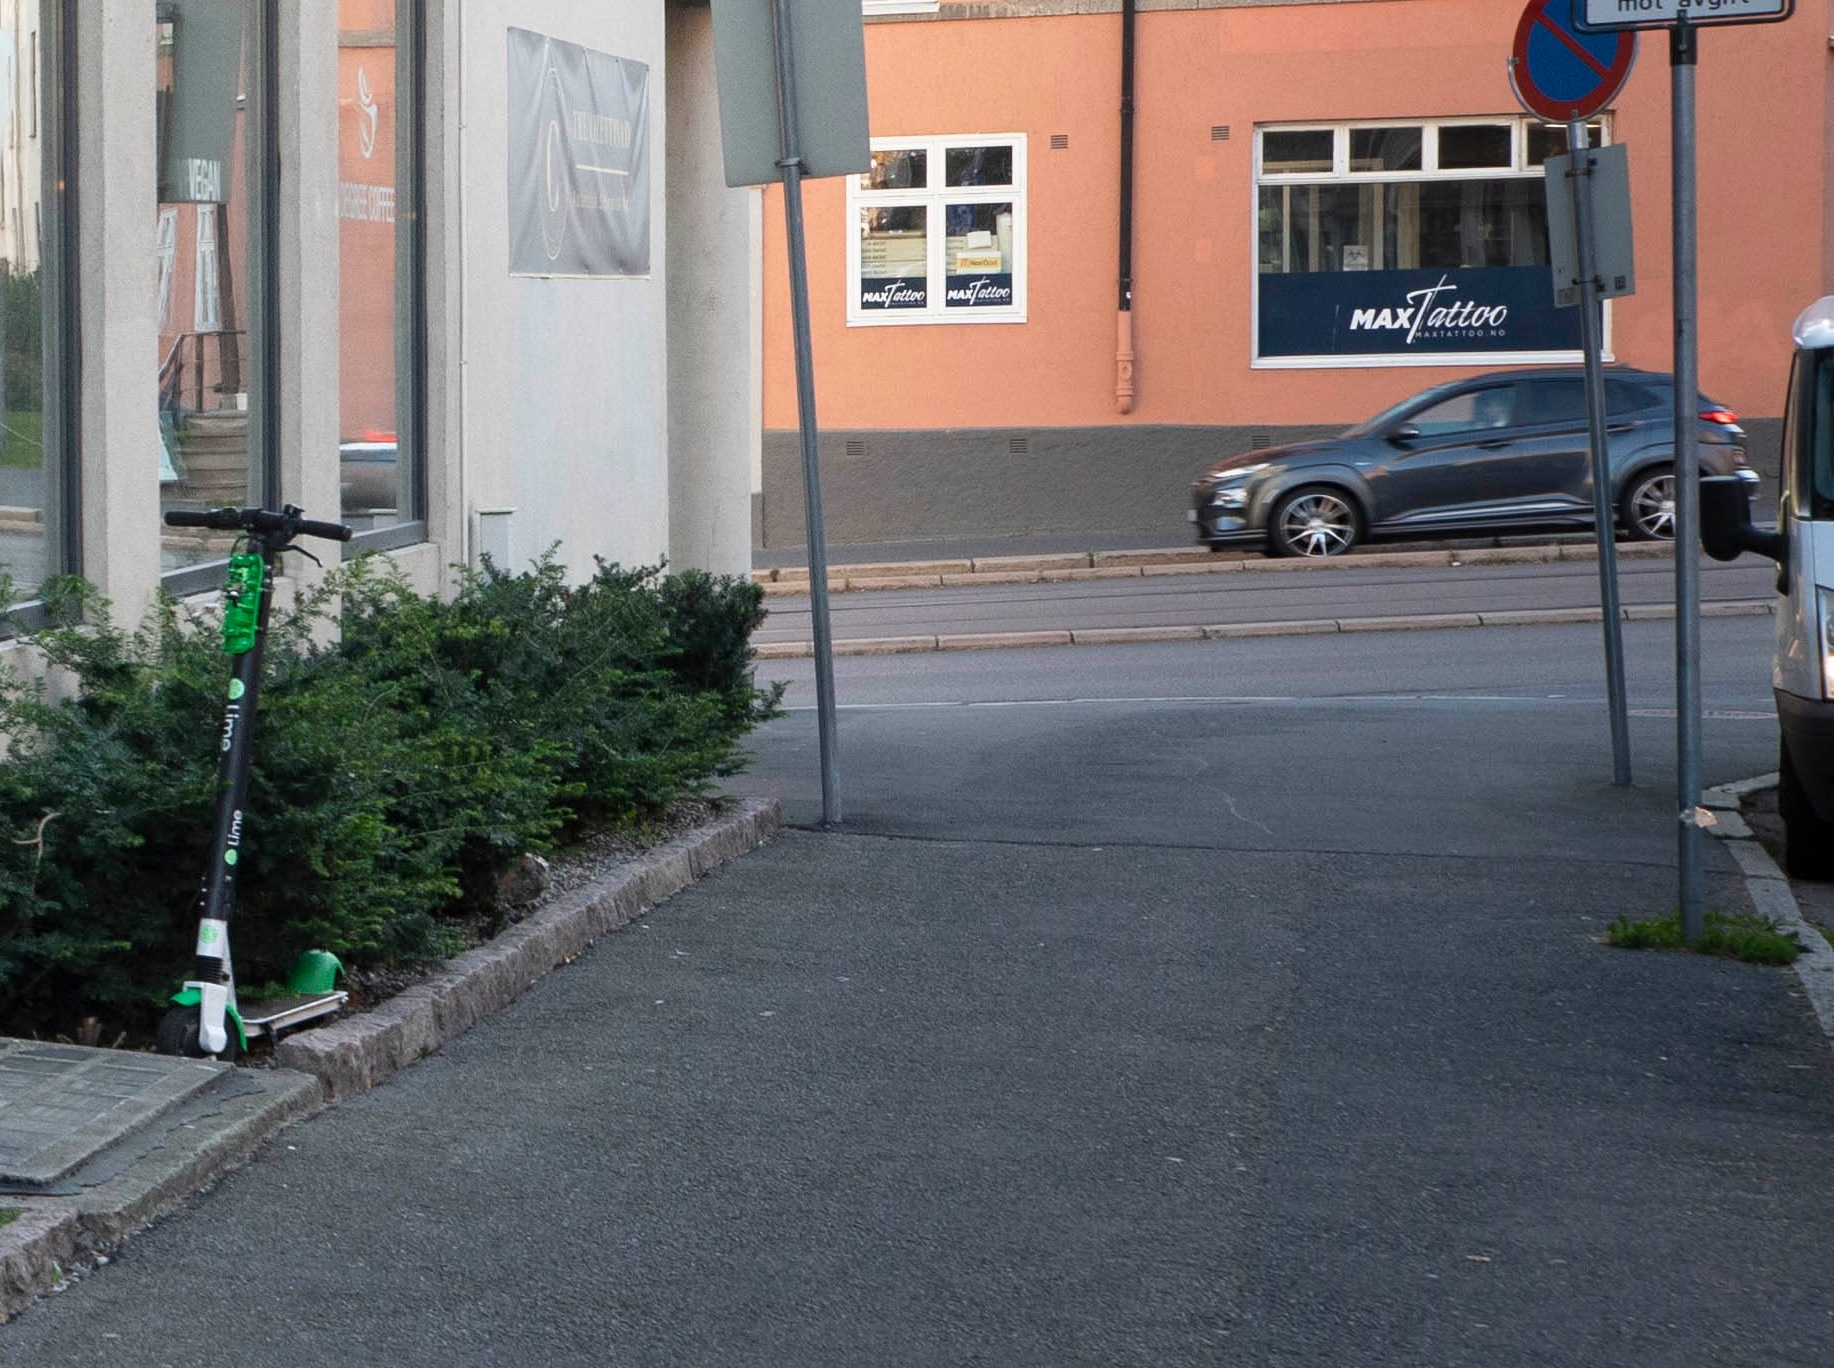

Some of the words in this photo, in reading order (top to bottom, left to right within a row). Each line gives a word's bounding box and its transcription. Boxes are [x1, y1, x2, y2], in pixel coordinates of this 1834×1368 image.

[188, 157, 222, 202] VEGAN
[221, 703, 240, 752] Lime
[227, 809, 243, 847] Lime
